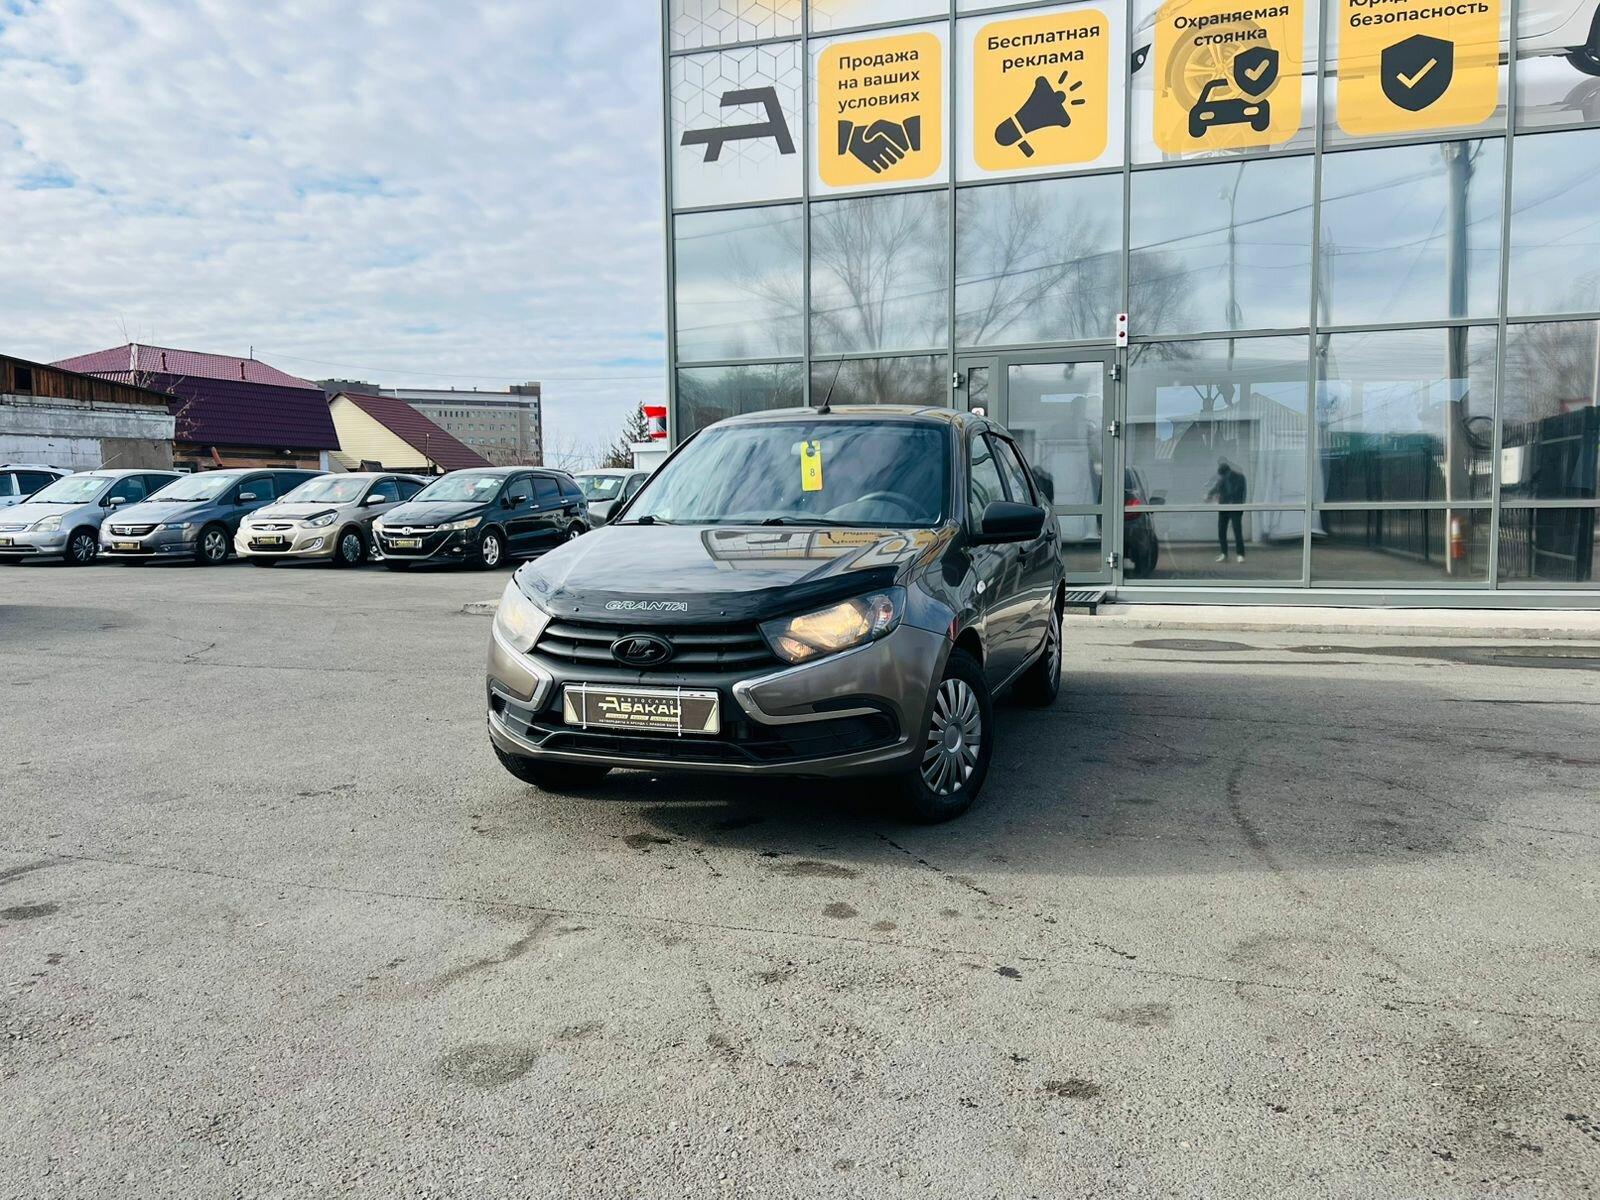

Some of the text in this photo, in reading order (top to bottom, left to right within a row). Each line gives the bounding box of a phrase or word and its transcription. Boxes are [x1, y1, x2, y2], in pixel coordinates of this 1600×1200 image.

[1174, 6, 1289, 30] Охраняемая
[1349, 3, 1489, 28] безопасность
[988, 25, 1100, 51] Бесплатная
[1193, 28, 1267, 48] стоянка
[838, 50, 919, 70] Продажа
[1002, 49, 1084, 73] реклама
[838, 71, 920, 90] на ваших
[838, 91, 920, 114] условиях
[605, 600, 688, 612] GRANTA
[620, 697, 681, 705] АВТОСАЛО
